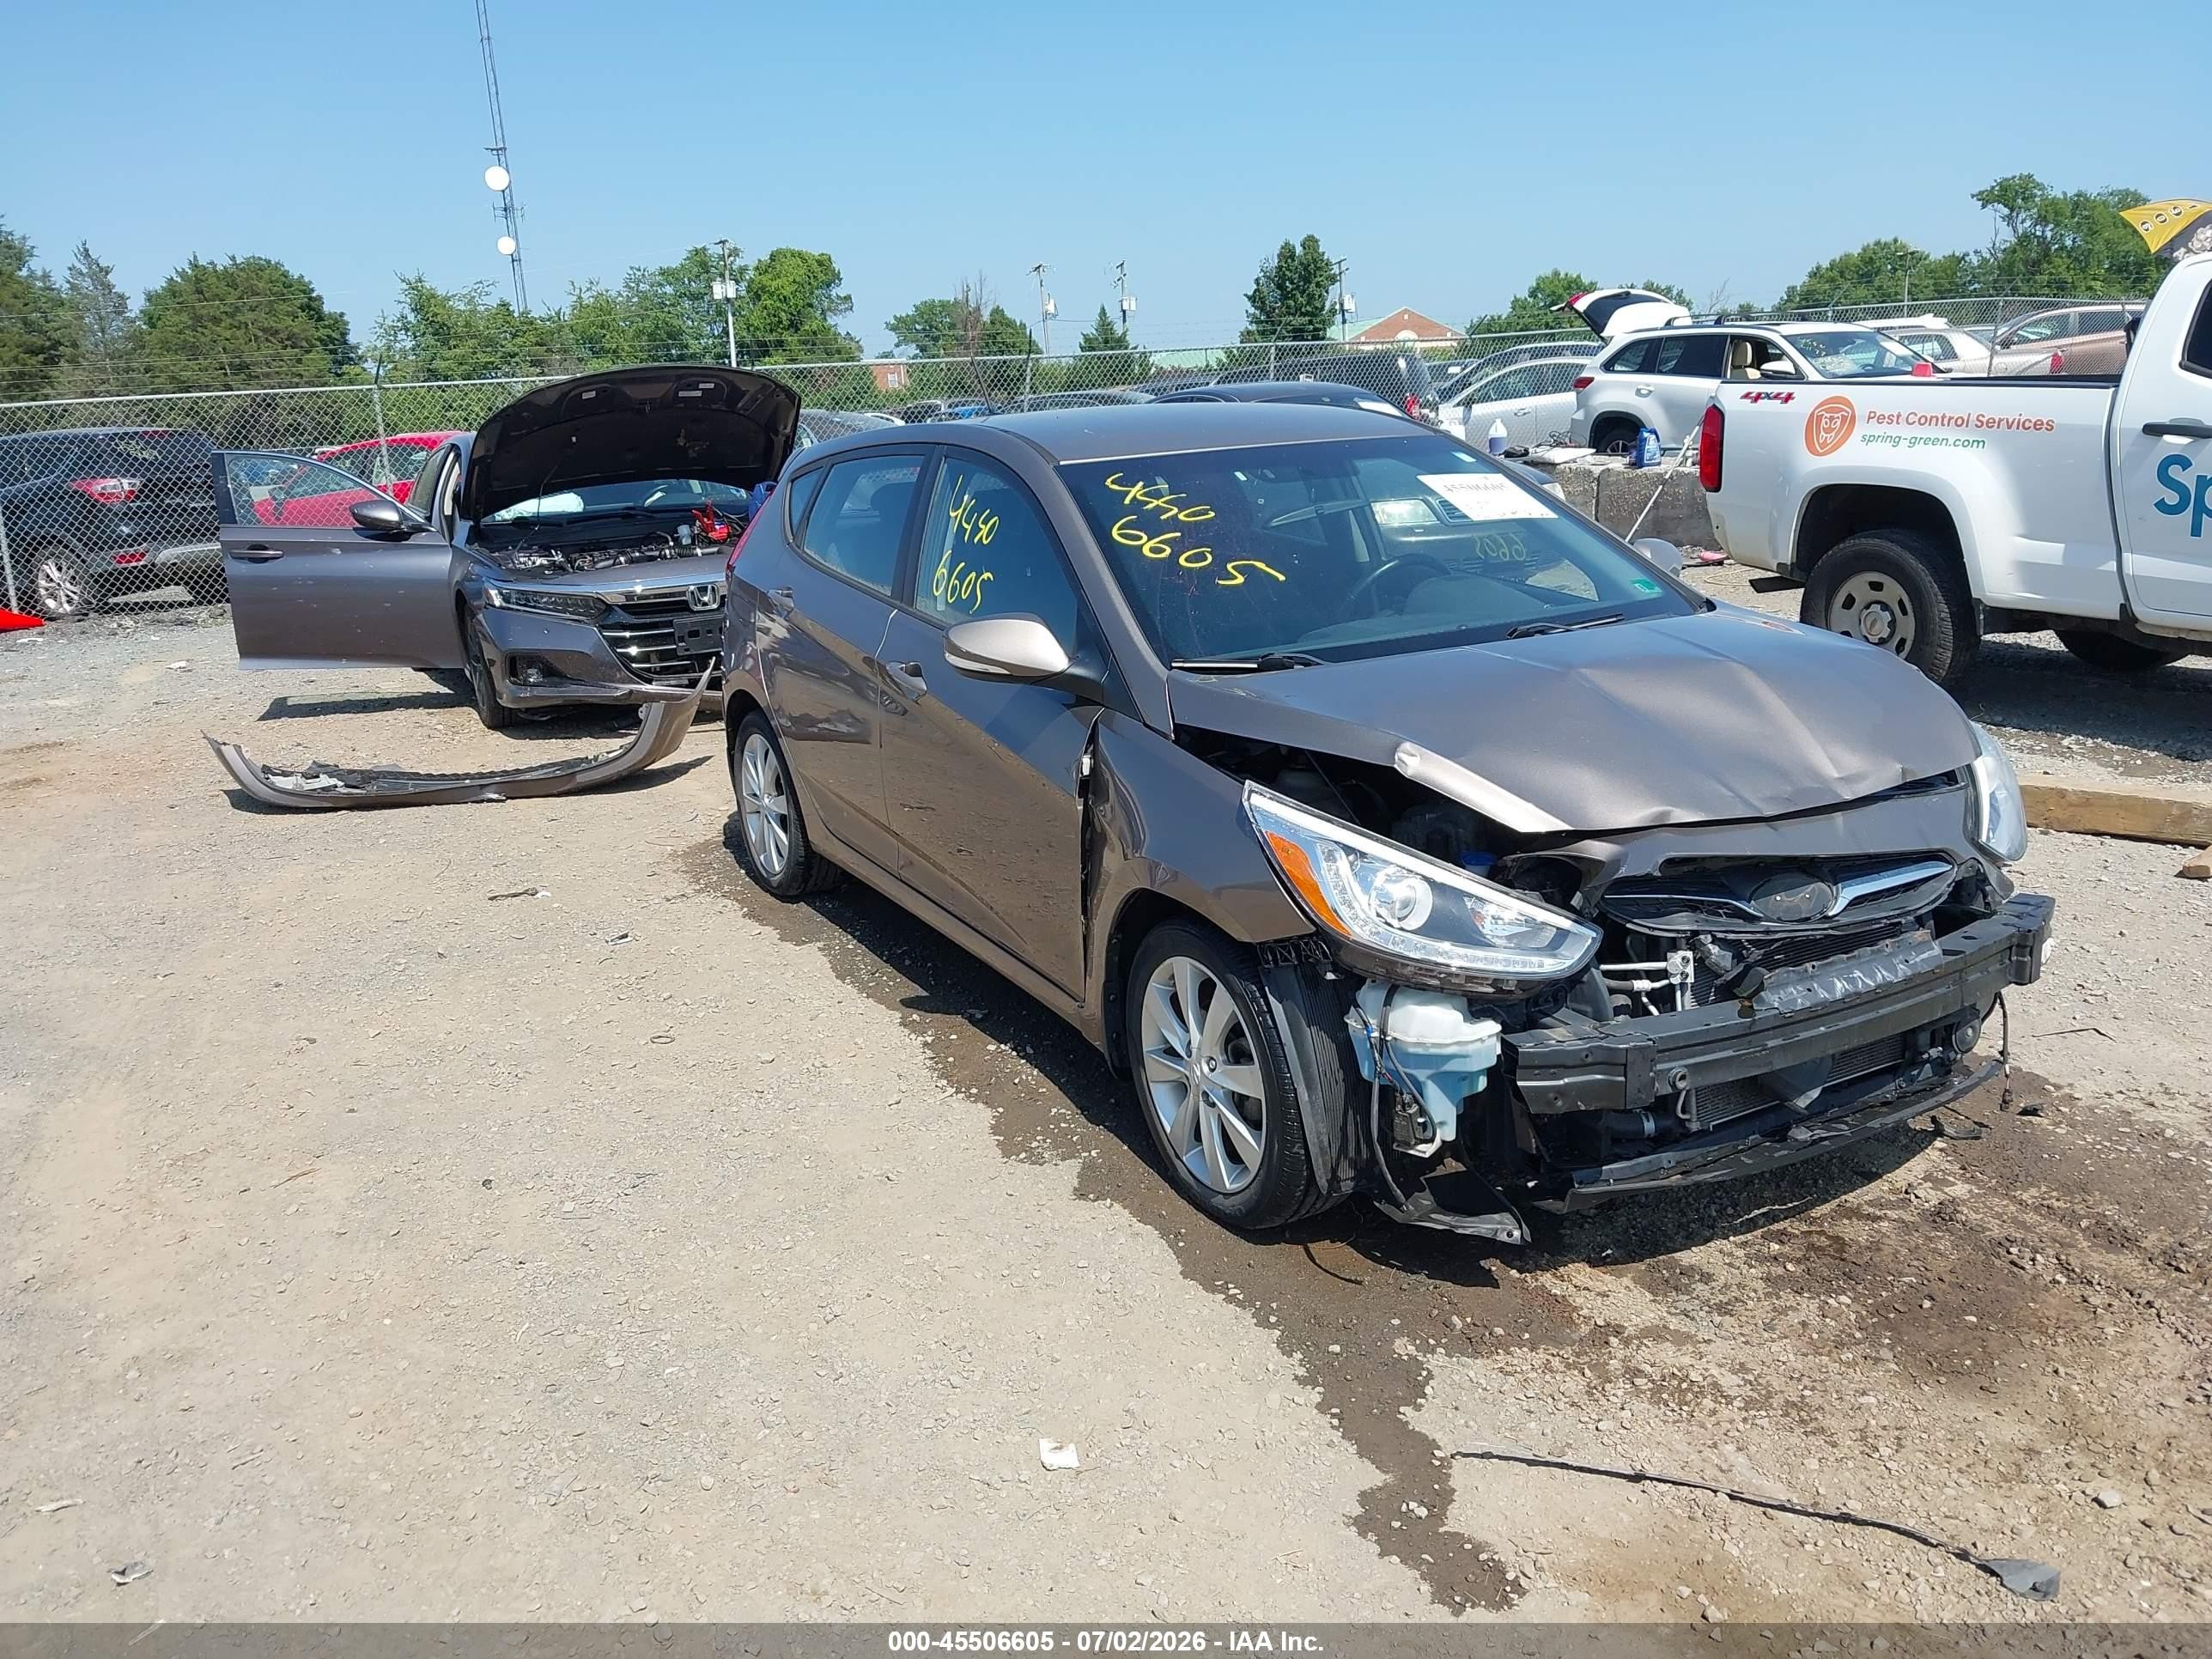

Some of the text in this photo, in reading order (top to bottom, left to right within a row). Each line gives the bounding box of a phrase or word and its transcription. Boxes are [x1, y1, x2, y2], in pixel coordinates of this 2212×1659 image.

[1860, 431, 1985, 449] spring-green.com
[1866, 410, 2055, 432] Pest Control Services
[1111, 515, 1286, 586] 6605
[933, 550, 994, 615] 6605
